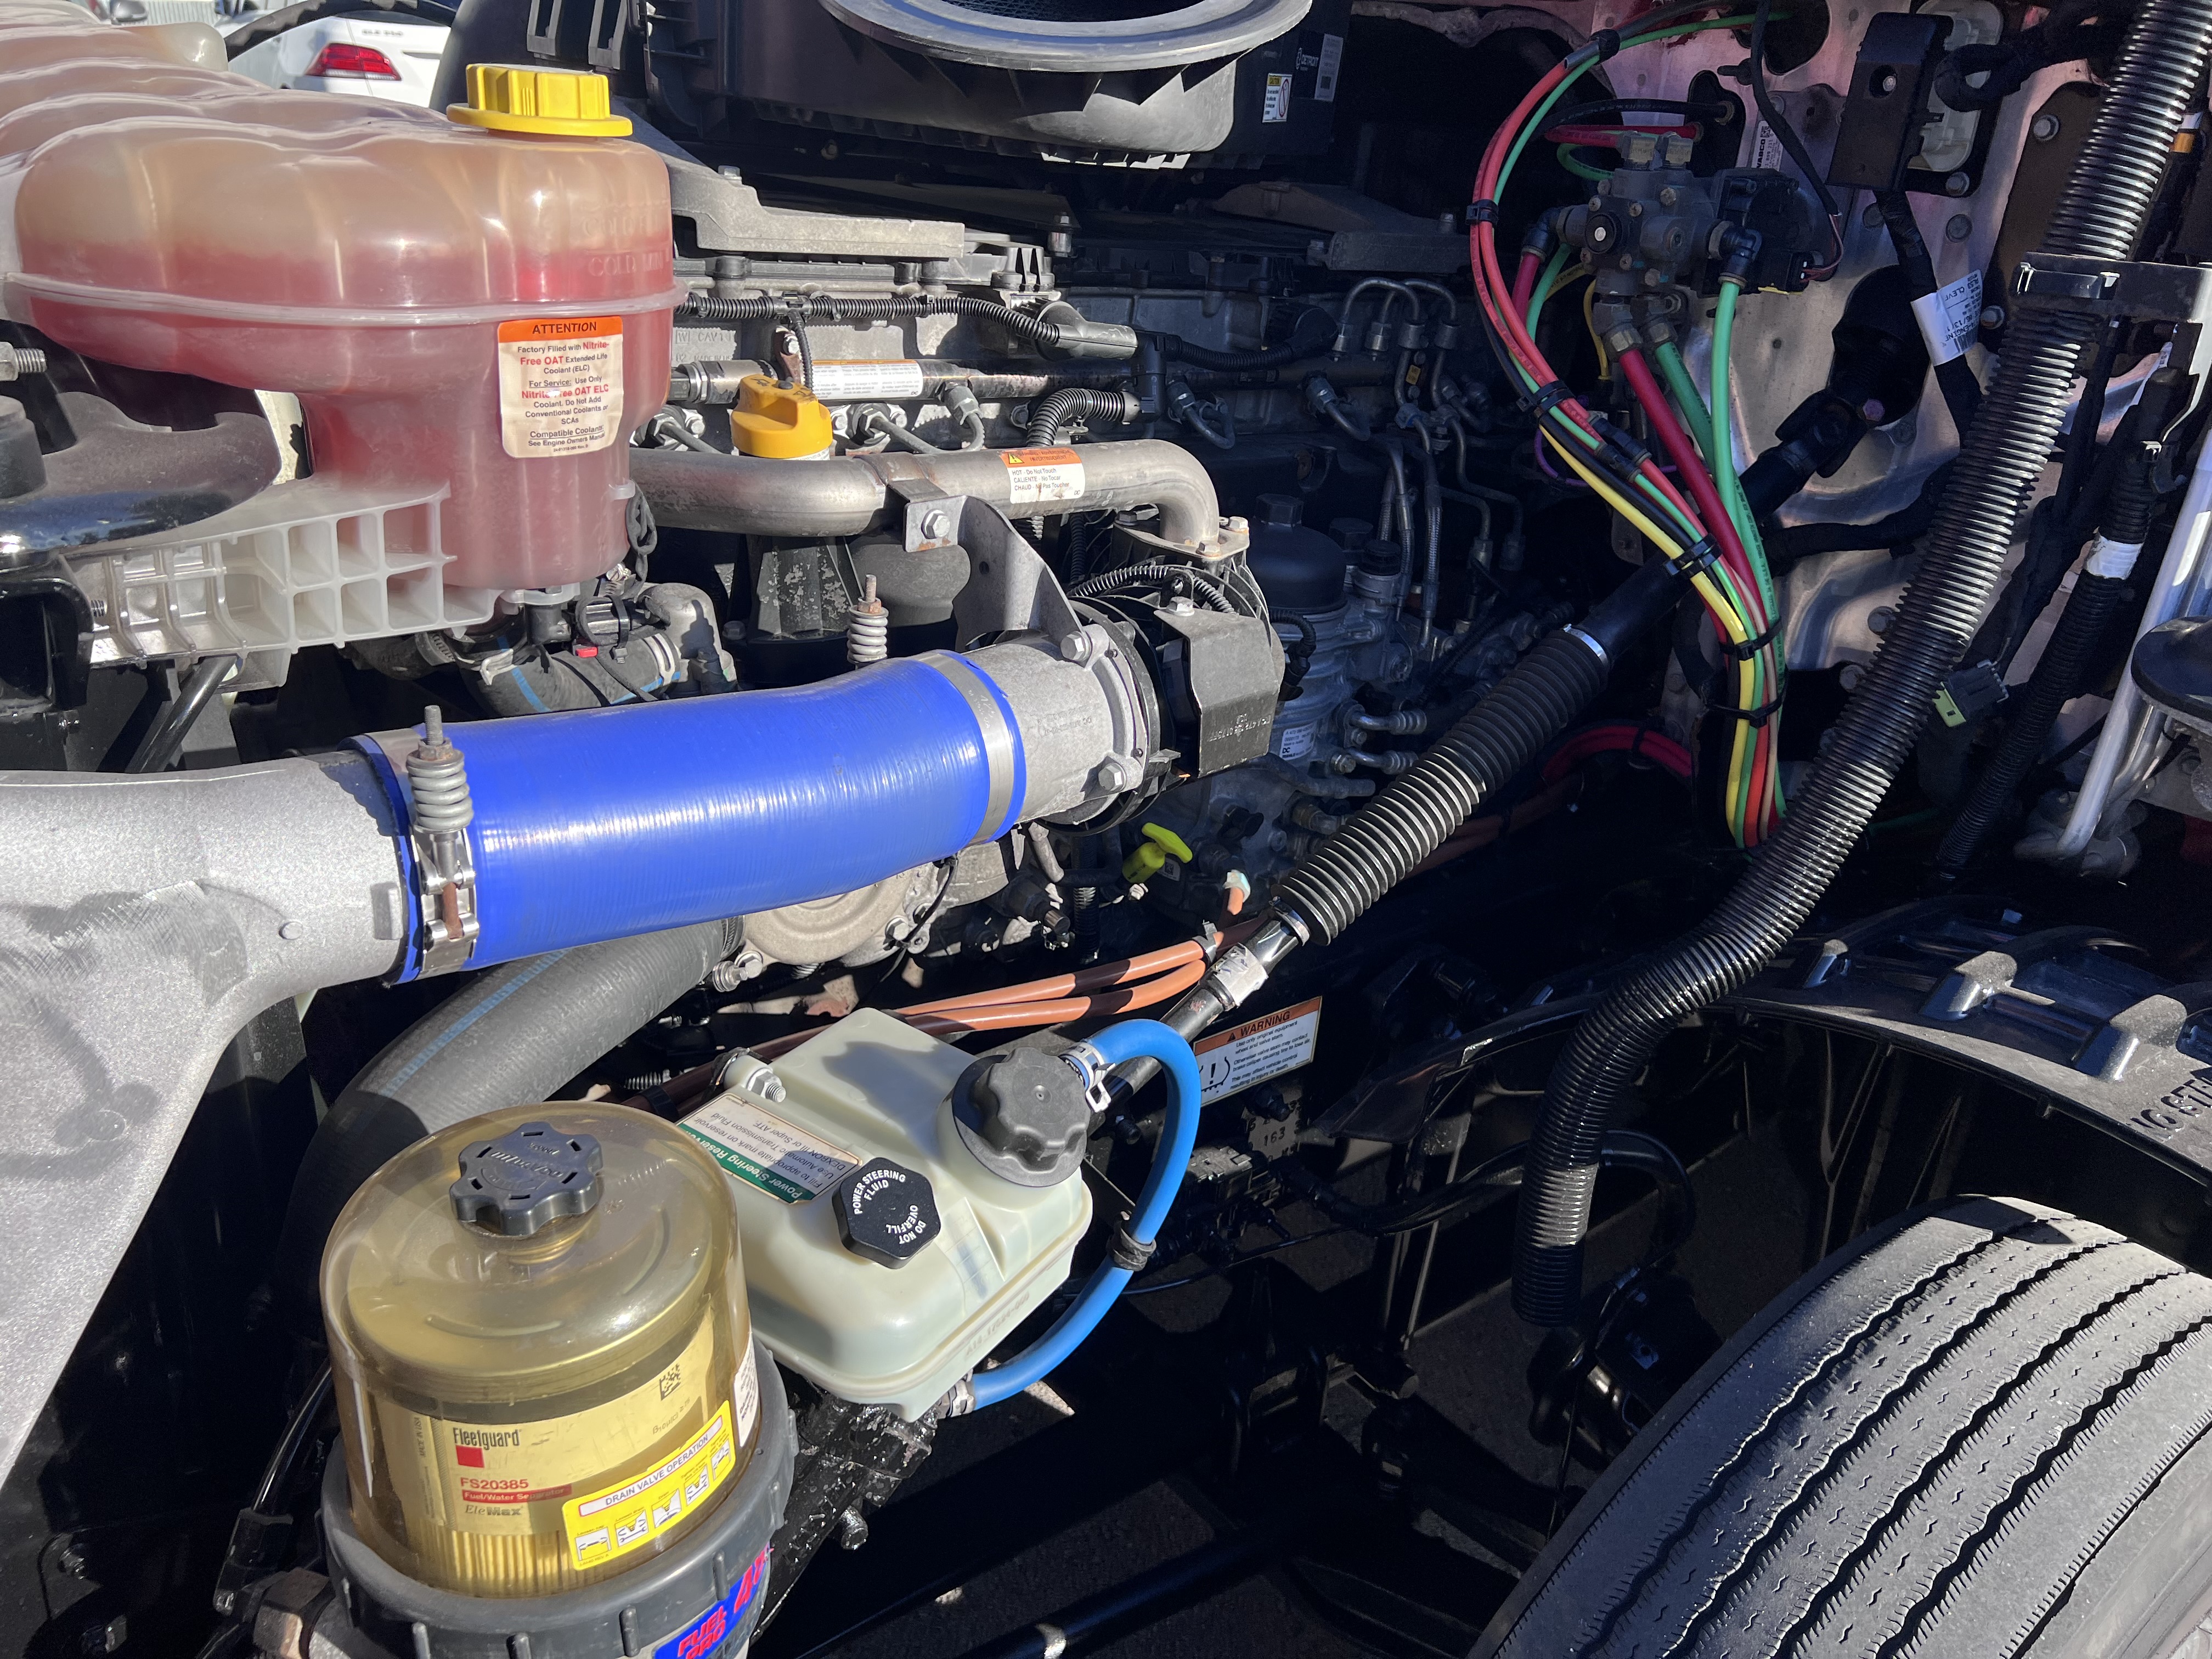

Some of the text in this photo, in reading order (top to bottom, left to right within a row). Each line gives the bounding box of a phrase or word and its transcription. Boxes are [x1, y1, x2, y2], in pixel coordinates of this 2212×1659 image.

[532, 321, 597, 334] ATTENTION
[583, 341, 610, 350] Nitrite-
[520, 357, 542, 365] Free
[544, 356, 563, 365] OAT
[566, 354, 595, 363] Extended
[572, 364, 590, 373] (ELC)
[544, 379, 572, 387] Service:
[574, 386, 591, 396] OAT
[594, 384, 609, 393] ELC
[525, 409, 572, 417] Conventional
[573, 405, 601, 414] Coolants
[534, 400, 563, 408] Coolant.
[530, 430, 573, 439] Compatible
[543, 438, 566, 447] Engine
[1241, 1011, 1290, 1037] WARNING
[1257, 1030, 1274, 1040] original
[1274, 1020, 1297, 1033] equipment
[1234, 1054, 1257, 1065] Otherwise
[1292, 1033, 1308, 1042] contact
[1235, 1046, 1249, 1054] wheel
[1233, 1063, 1246, 1072] brake
[1246, 1058, 1262, 1067] caliper
[1262, 1051, 1280, 1060] causing
[1252, 1066, 1265, 1075] affect
[1266, 1059, 1282, 1069] vehicle
[1282, 1053, 1298, 1063] control
[1230, 1078, 1250, 1090] resulting
[1256, 1071, 1268, 1080] injury
[695, 1117, 727, 1137] reservoir.
[770, 1129, 793, 1143] Super
[711, 1113, 834, 1180] Use Automatic Transmission Fluid
[738, 1140, 758, 1153] mark
[727, 1154, 770, 1181] Steering
[758, 1150, 801, 1175] appropriate
[808, 1150, 846, 1171] DEXRON
[769, 1178, 803, 1199] Power
[808, 1178, 823, 1188] Fill
[853, 1169, 906, 1215] POWER STEERING
[864, 1180, 889, 1201] FLUID
[885, 1205, 918, 1234] OVERFILL
[899, 1220, 927, 1244] DO NOT
[453, 1427, 520, 1451] Fleetguard
[606, 1487, 635, 1506] DRAIN
[637, 1470, 665, 1489] VALVE
[667, 1434, 708, 1473] OPERATION
[460, 1477, 529, 1490] FS20385
[465, 1488, 565, 1501] Fuel/Water Separator
[678, 1606, 727, 1657] FUEL
[686, 1620, 726, 1659] PRO
